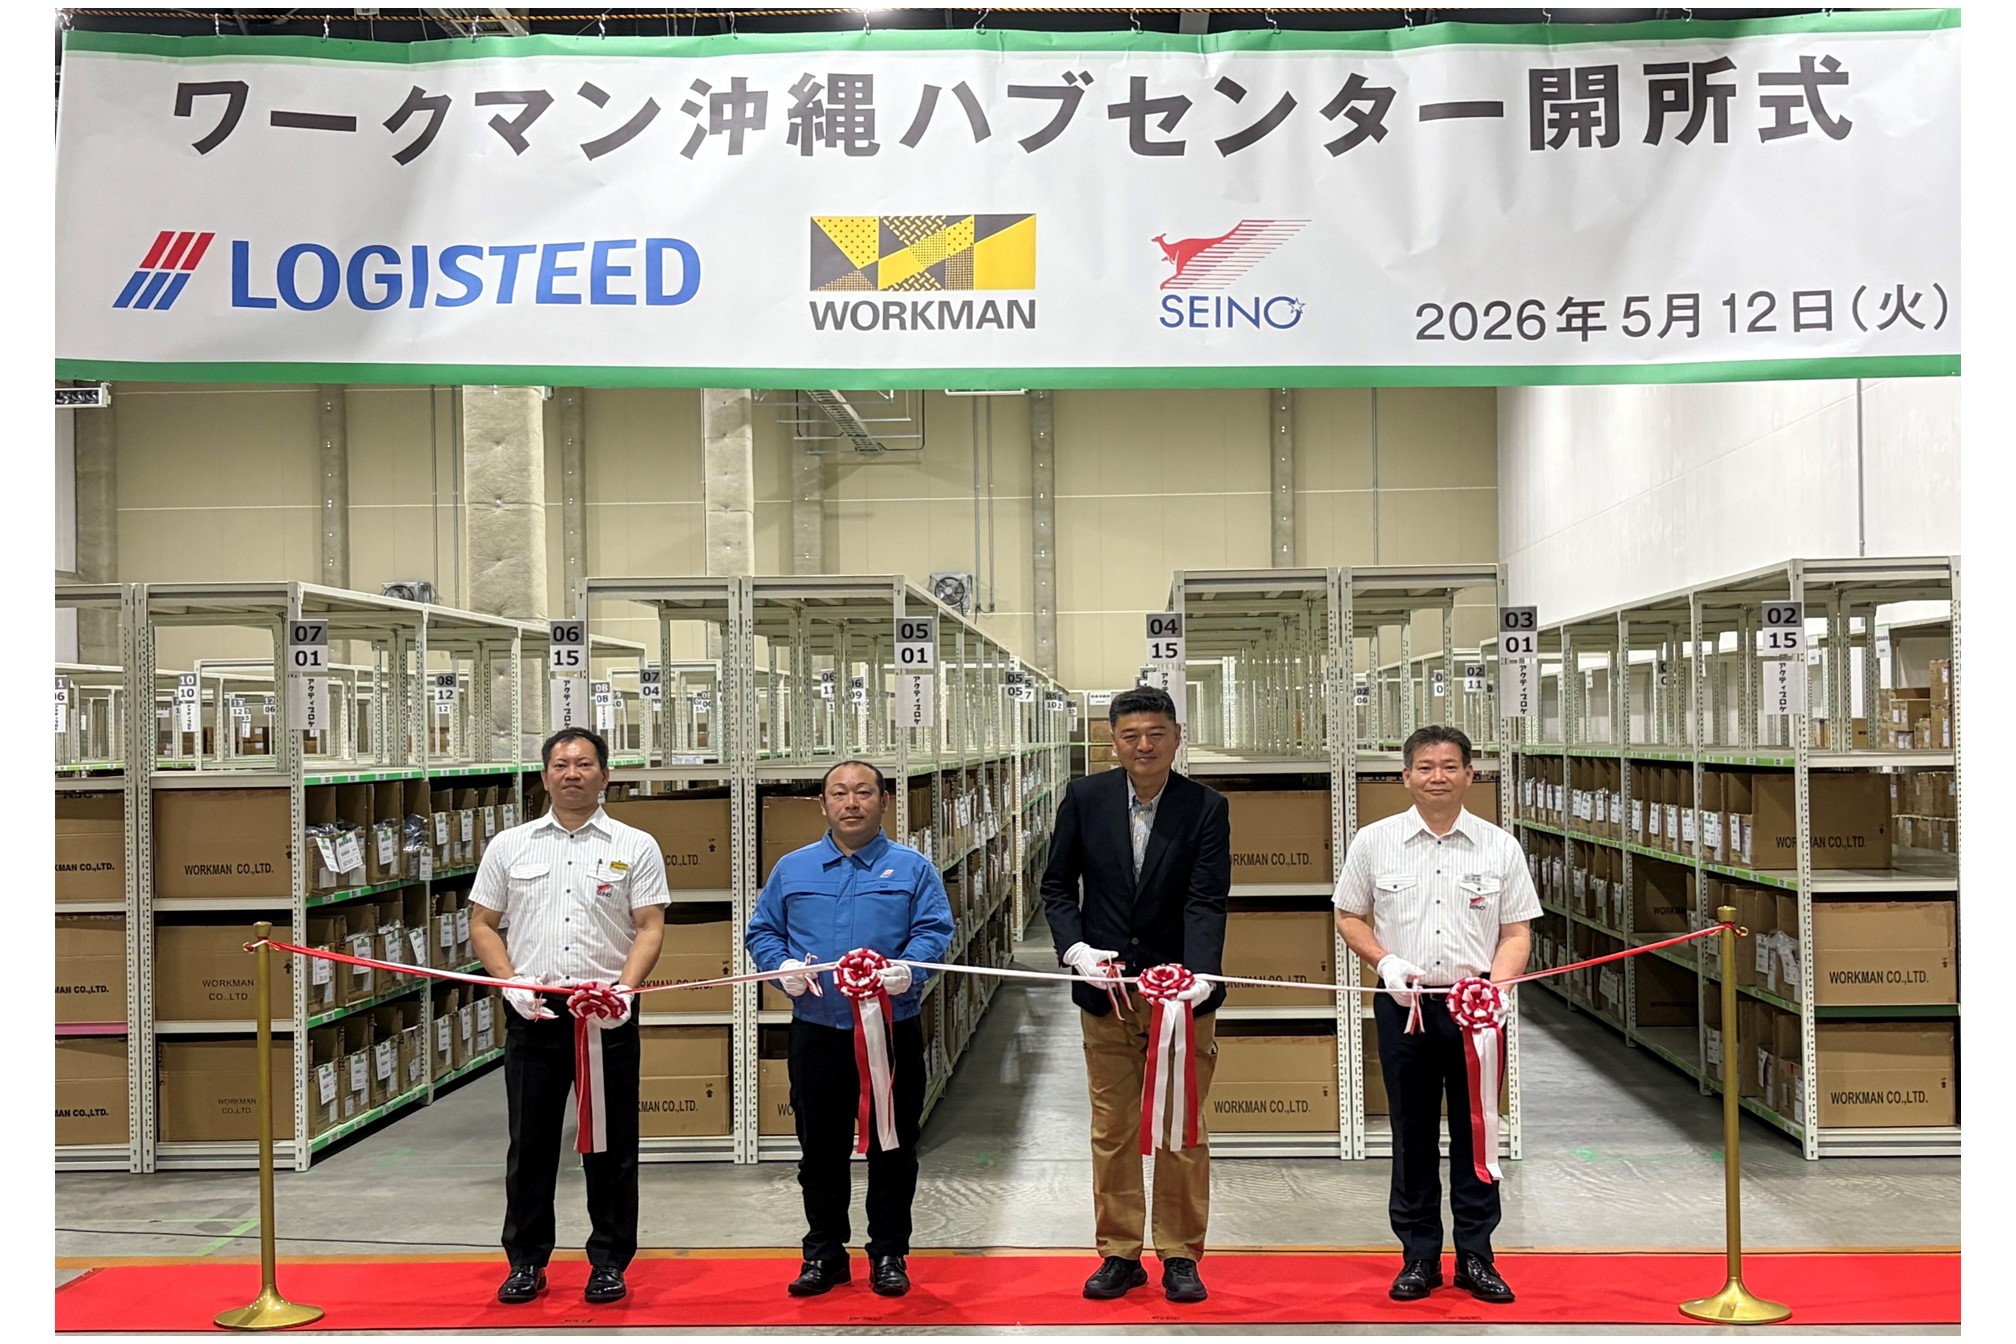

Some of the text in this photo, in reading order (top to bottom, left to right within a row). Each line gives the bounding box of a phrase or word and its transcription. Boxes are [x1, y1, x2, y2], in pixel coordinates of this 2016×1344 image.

[173, 55, 1854, 163] ワークマン沖縄ハブセンター開所式
[231, 238, 701, 311] LOGISTEED
[809, 299, 1037, 331] WORKMAN
[1160, 294, 1306, 330] SEINO
[1505, 612, 1534, 628] 03
[1767, 608, 1797, 624] 02
[901, 623, 929, 639] 05
[1150, 619, 1178, 635] 04
[295, 626, 322, 642] 07
[553, 626, 579, 642] 06
[1768, 632, 1797, 649] 15
[1152, 643, 1178, 659] 15
[1505, 637, 1533, 653] 01
[295, 650, 322, 666] 01
[554, 650, 579, 666] 15
[901, 648, 928, 664] 01
[643, 672, 659, 682] 07
[1007, 674, 1023, 683] 05
[1467, 667, 1483, 677] 02
[180, 676, 195, 686] 10
[437, 675, 454, 686] 08
[1025, 679, 1032, 688] 5
[1467, 680, 1483, 689] 11
[180, 688, 195, 698] 10
[595, 684, 608, 692] 08
[643, 686, 660, 696] 04
[1007, 687, 1023, 696] 05
[438, 690, 454, 700] 12
[596, 694, 609, 703] 08
[1827, 836, 1867, 849] CO.,LTD.
[666, 854, 701, 867] CO.,LTD.
[1230, 853, 1312, 867] RKMAN CO.,LTD.
[80, 863, 115, 872] CO.,LTD.
[185, 863, 274, 875] WORKMAN CO.,LTD.
[202, 979, 254, 988] WORKMAN
[1829, 970, 1929, 985] WORKMAN CO.,LTD.
[73, 985, 109, 995] CO.,LTD.
[1830, 1090, 1928, 1105] WORKMAN CO.,LTD.
[662, 1100, 698, 1113] CO.,LTD.
[1214, 1100, 1311, 1114] WORKMAN CO.,LTD.
[73, 1109, 109, 1118] CO.,LTD.
